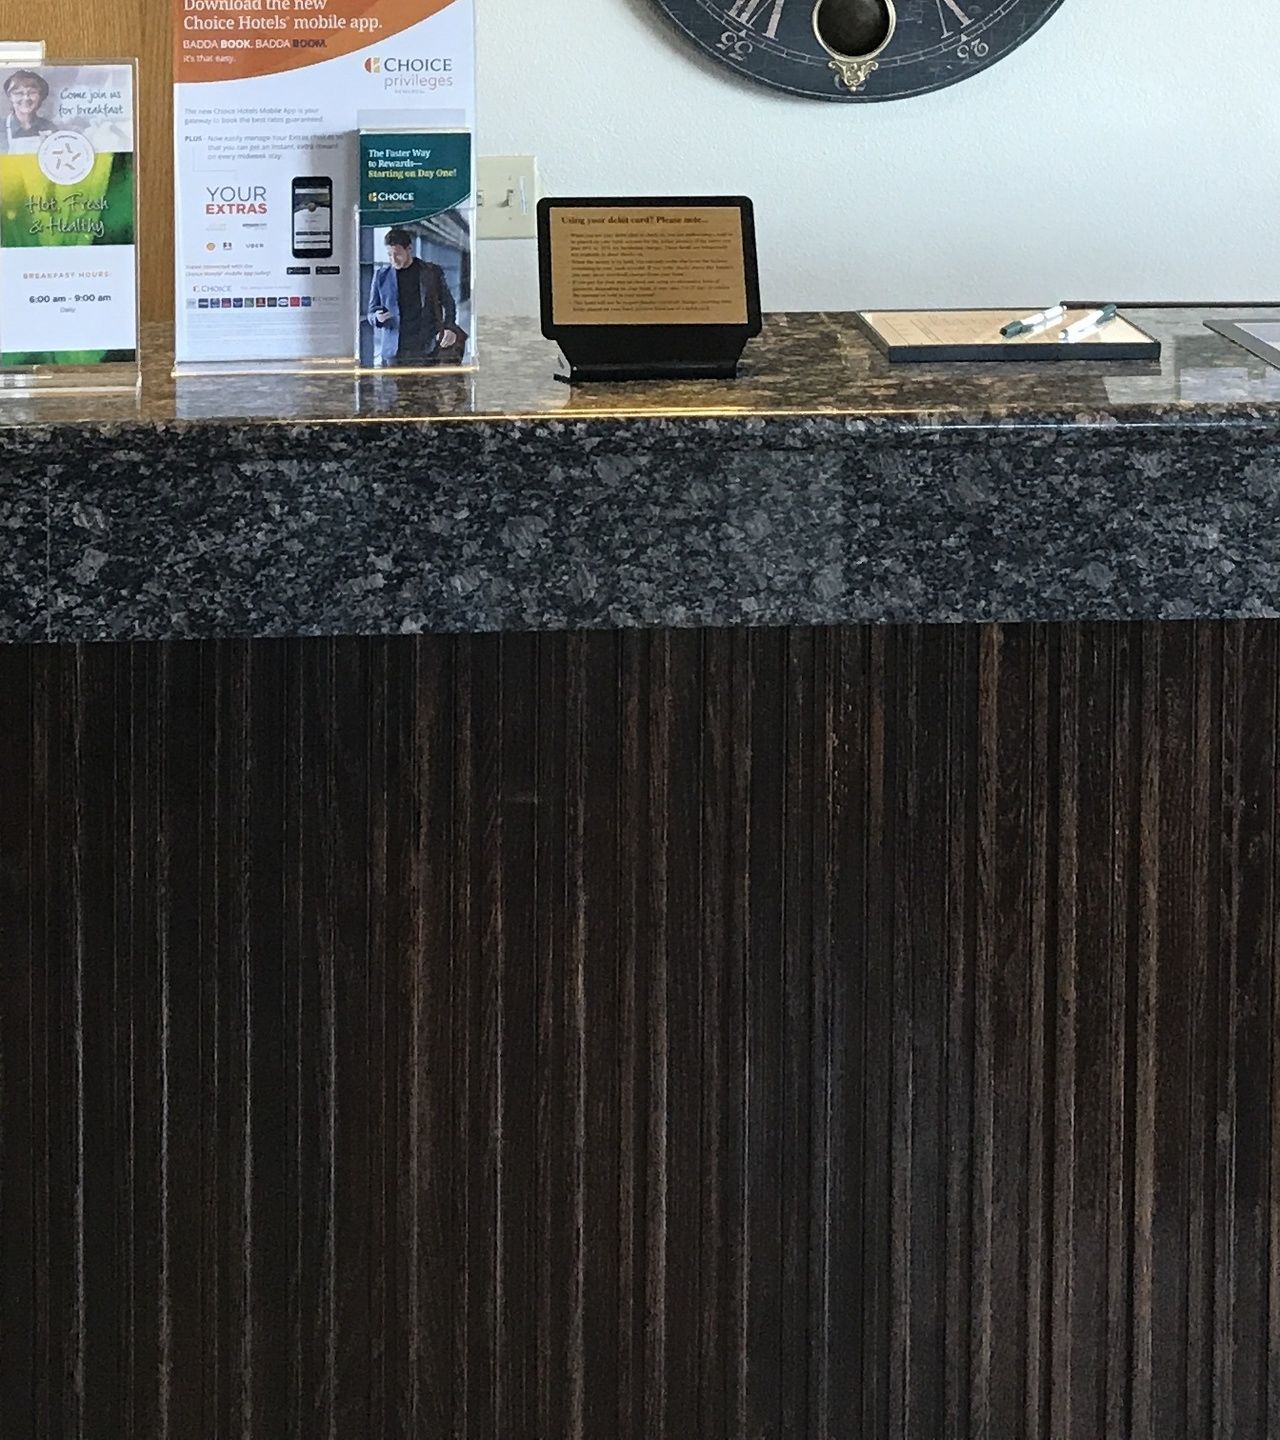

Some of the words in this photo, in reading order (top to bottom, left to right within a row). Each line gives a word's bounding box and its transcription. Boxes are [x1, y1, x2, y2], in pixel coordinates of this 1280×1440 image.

[183, 16, 234, 30] Choice
[294, 15, 346, 29] mobile
[350, 18, 382, 32] app.
[183, 40, 218, 49] BADDA
[220, 39, 253, 49] BOOK.
[256, 39, 290, 49] BADDA
[956, 38, 989, 60] 25
[196, 55, 213, 63] that
[384, 58, 452, 72] CHOICE
[384, 74, 453, 90] privileges
[60, 88, 86, 99] Come
[89, 89, 107, 102] join
[110, 91, 121, 99] us
[59, 105, 74, 118] for
[77, 104, 124, 117] breakfast
[369, 149, 384, 158] The
[385, 149, 411, 158] Faster
[412, 149, 431, 159] Way
[368, 169, 404, 179] Starting
[418, 169, 435, 178] Day
[436, 169, 457, 177] One!
[206, 186, 267, 202] YOUR
[378, 192, 415, 201] CHOICE
[25, 195, 61, 215] Hot,
[64, 193, 109, 210] Fresh
[205, 203, 268, 215] EXTRAS
[29, 219, 43, 234] &
[45, 217, 105, 237] Healthy
[562, 216, 585, 225] Using
[587, 217, 605, 225] your
[608, 216, 629, 224] debit
[656, 216, 681, 224] Please
[29, 295, 50, 303] 6:00
[74, 294, 95, 302] 9:00
